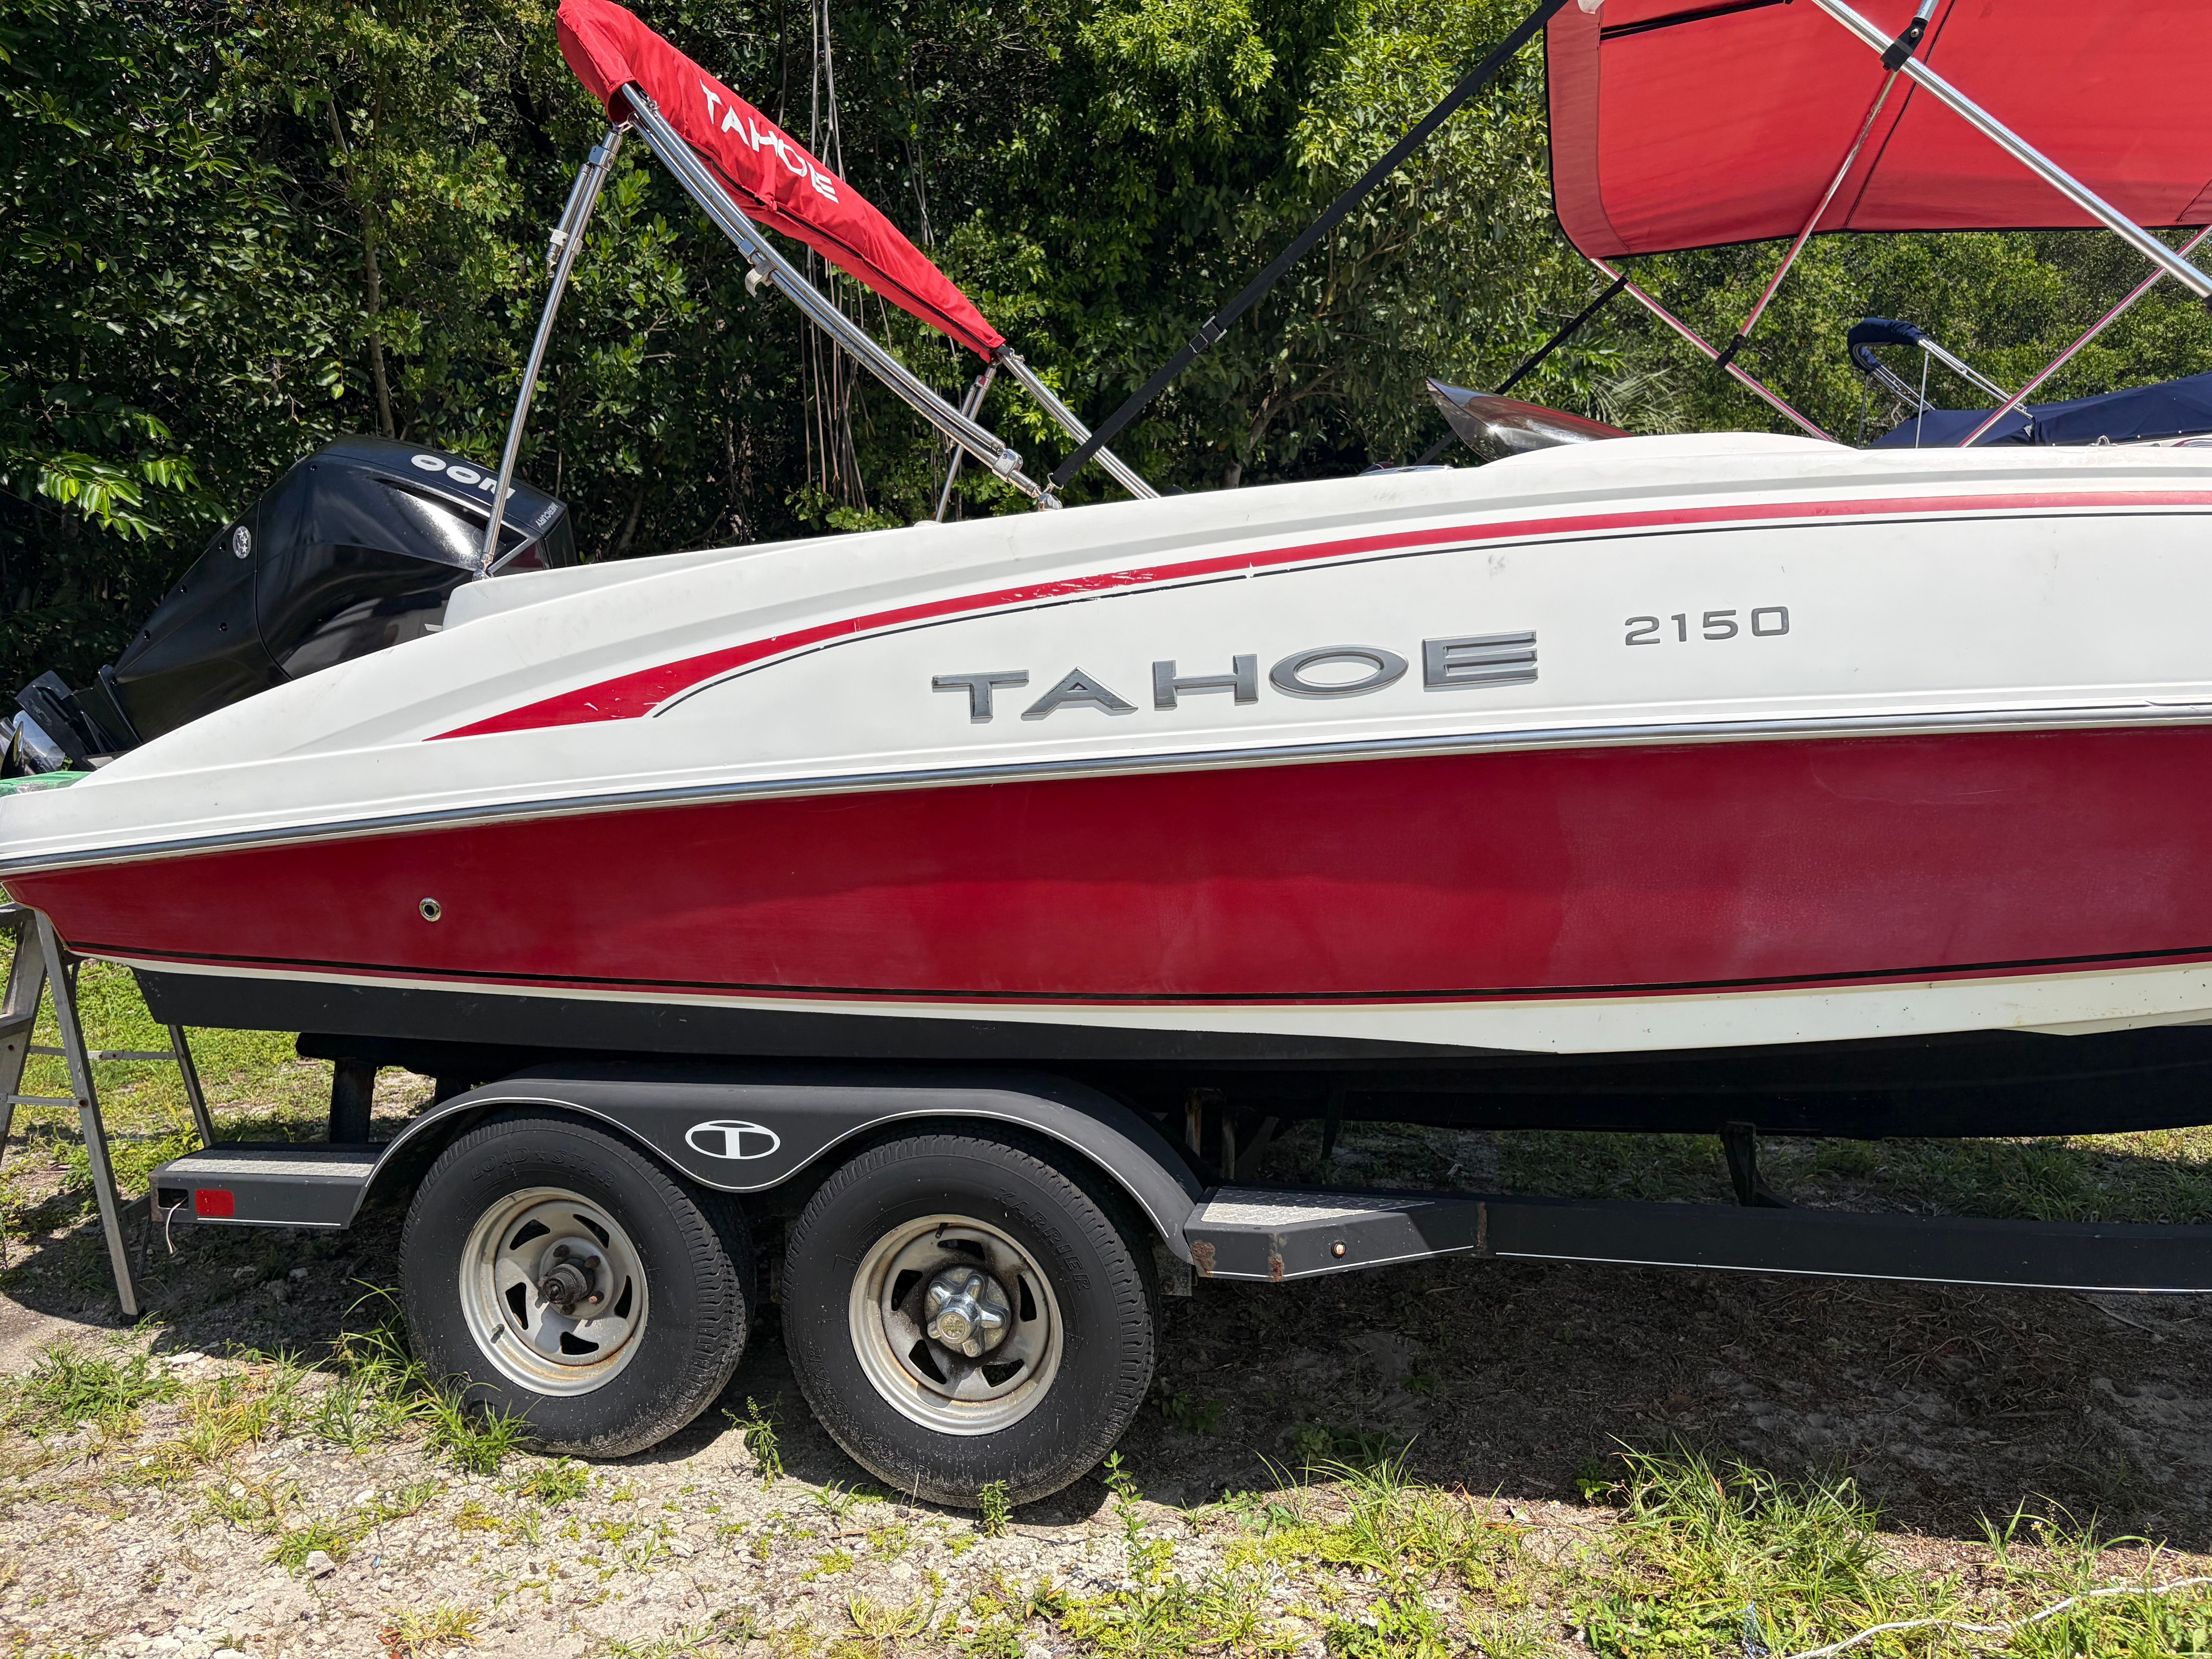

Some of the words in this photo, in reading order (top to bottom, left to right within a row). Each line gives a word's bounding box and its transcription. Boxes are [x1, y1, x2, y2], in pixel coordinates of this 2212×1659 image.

[699, 78, 839, 204] TAHOE
[535, 501, 558, 528] MERCURY
[1625, 606, 1790, 646] 2150
[931, 630, 1539, 723] TAHOE
[994, 1187, 1092, 1290] KARRIER
